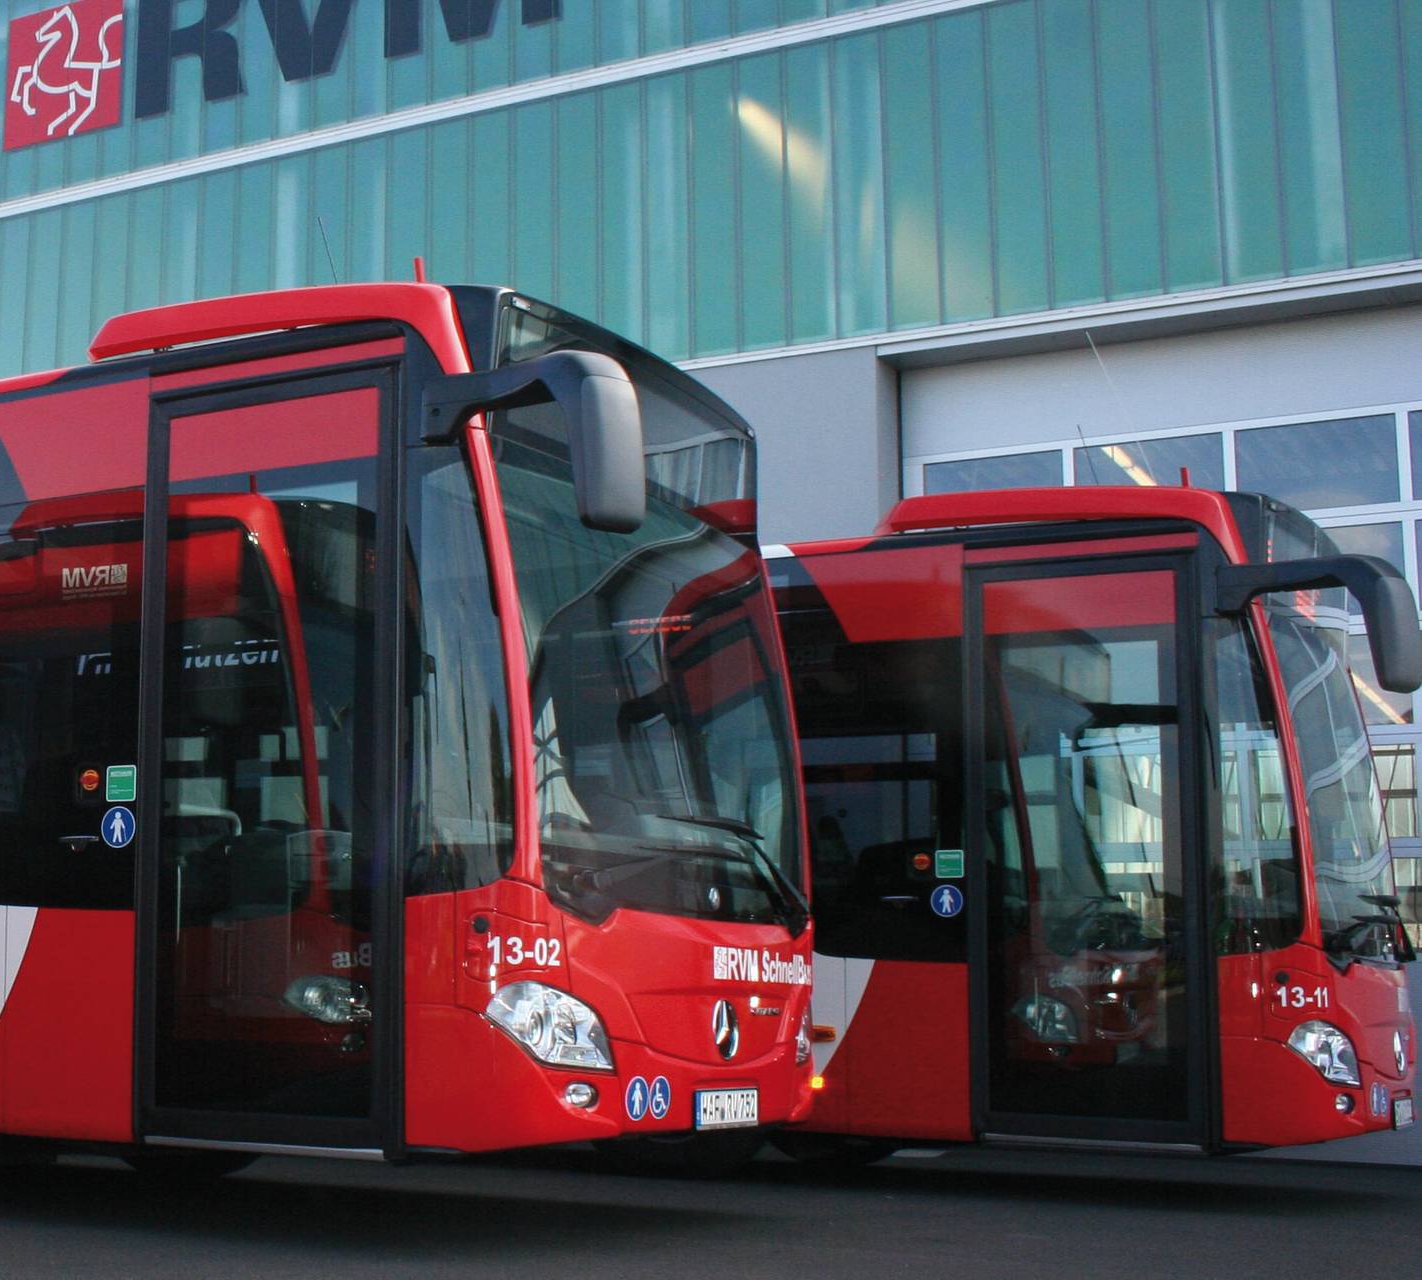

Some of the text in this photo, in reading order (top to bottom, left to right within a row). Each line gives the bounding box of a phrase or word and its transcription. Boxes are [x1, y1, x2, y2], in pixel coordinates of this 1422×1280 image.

[487, 935, 562, 966] 13-02
[728, 947, 759, 982] RVM
[1277, 986, 1329, 1008] 13-11
